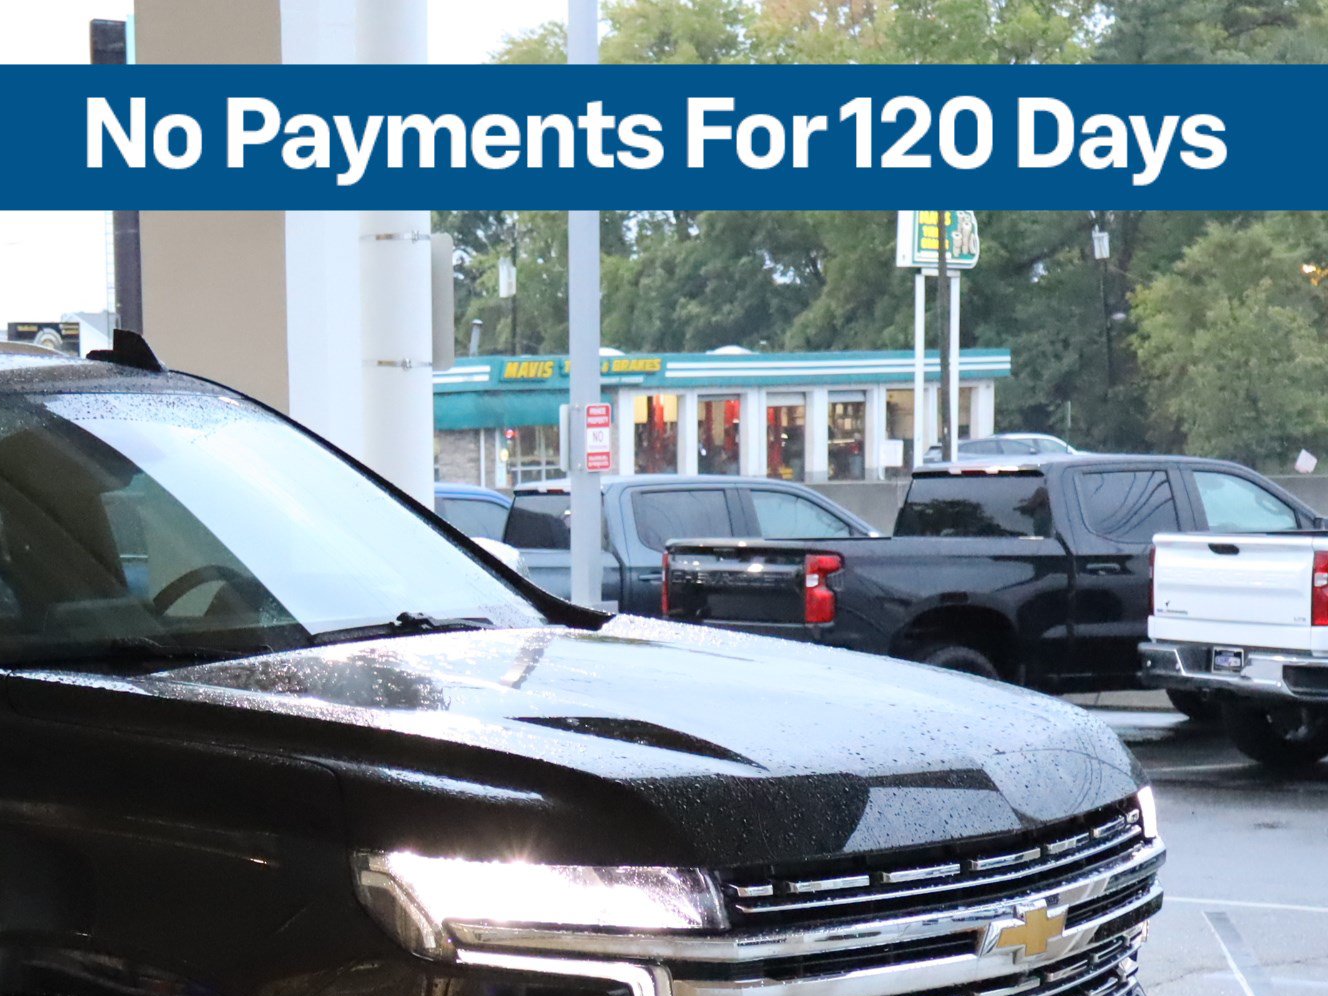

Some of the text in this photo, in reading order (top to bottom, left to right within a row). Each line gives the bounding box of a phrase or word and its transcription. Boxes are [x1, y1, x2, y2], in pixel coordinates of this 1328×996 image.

[504, 361, 554, 378] MAVIS
[612, 359, 663, 372] BRAKES
[592, 430, 604, 443] NO
